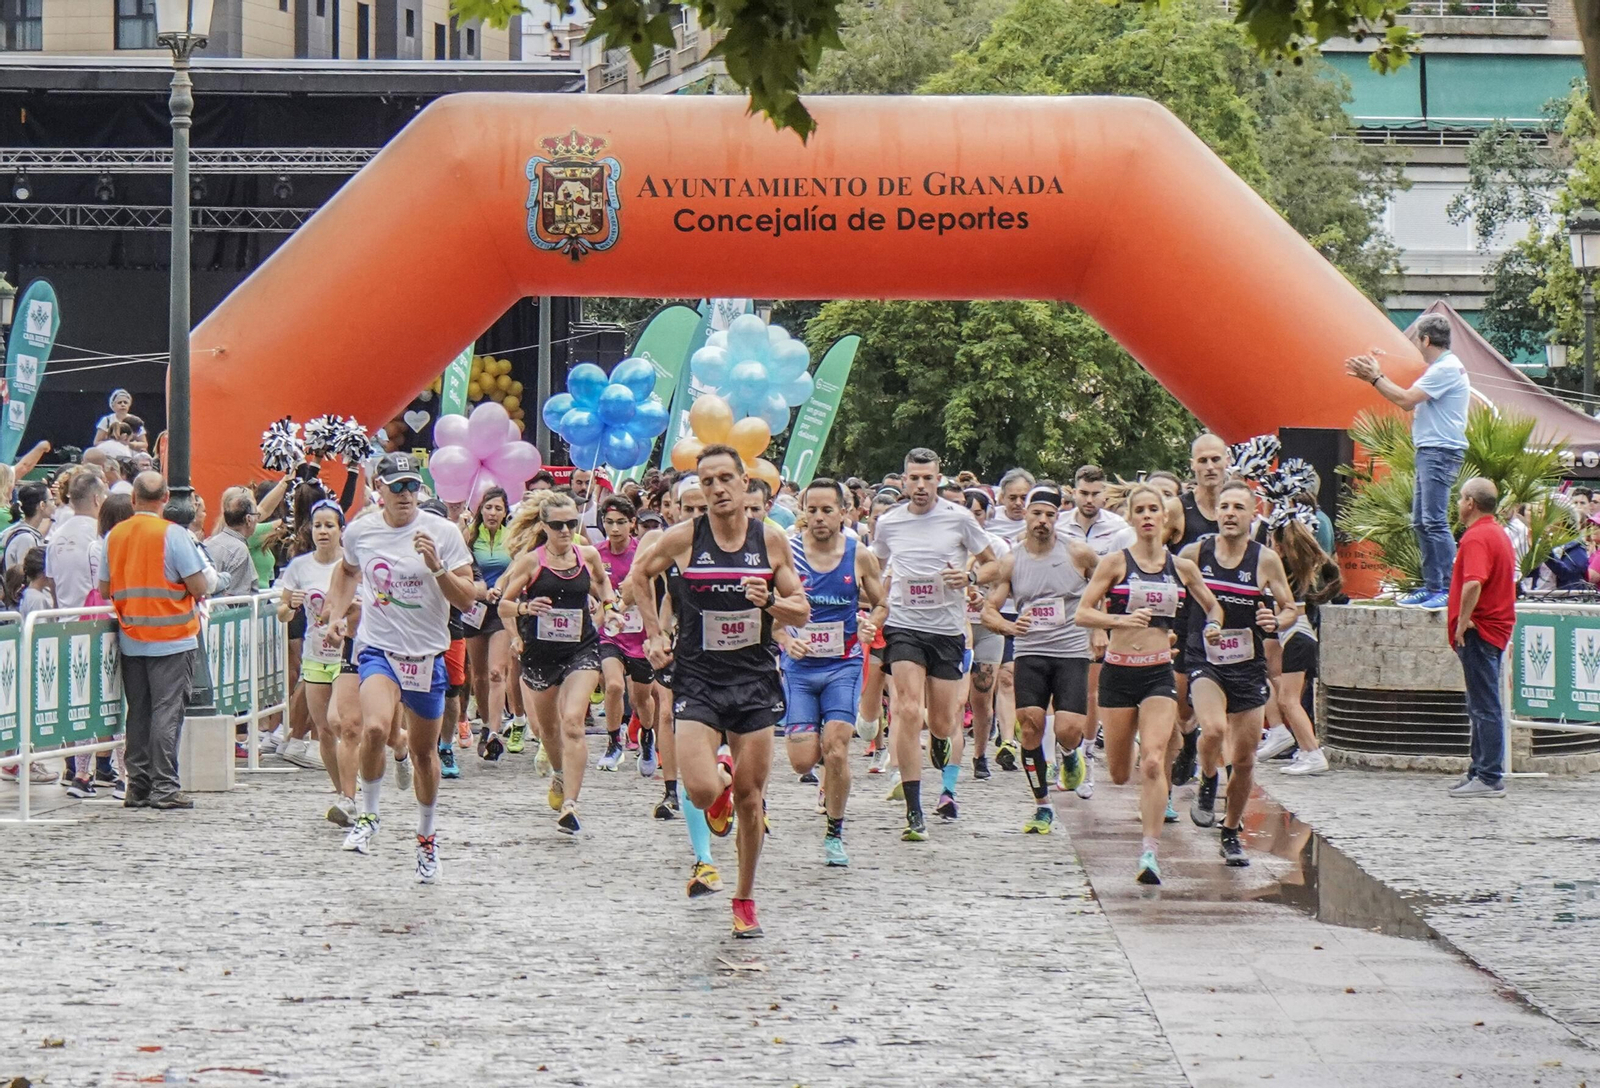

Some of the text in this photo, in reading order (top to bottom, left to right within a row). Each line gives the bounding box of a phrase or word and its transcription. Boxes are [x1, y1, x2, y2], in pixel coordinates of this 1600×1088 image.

[637, 171, 1065, 198] AYUNTAMIENTO DE GRANADA
[673, 204, 1030, 237] Concejalía de Deportes
[909, 584, 934, 596] 8042
[1145, 592, 1163, 604] 153
[1031, 606, 1055, 617] 8033
[552, 617, 569, 629] 164
[721, 621, 745, 635] 949
[727, 638, 749, 646] vithas
[810, 632, 830, 644] 843
[1219, 637, 1239, 651] 646
[1125, 654, 1157, 664] NIKE
[399, 662, 418, 676] 370
